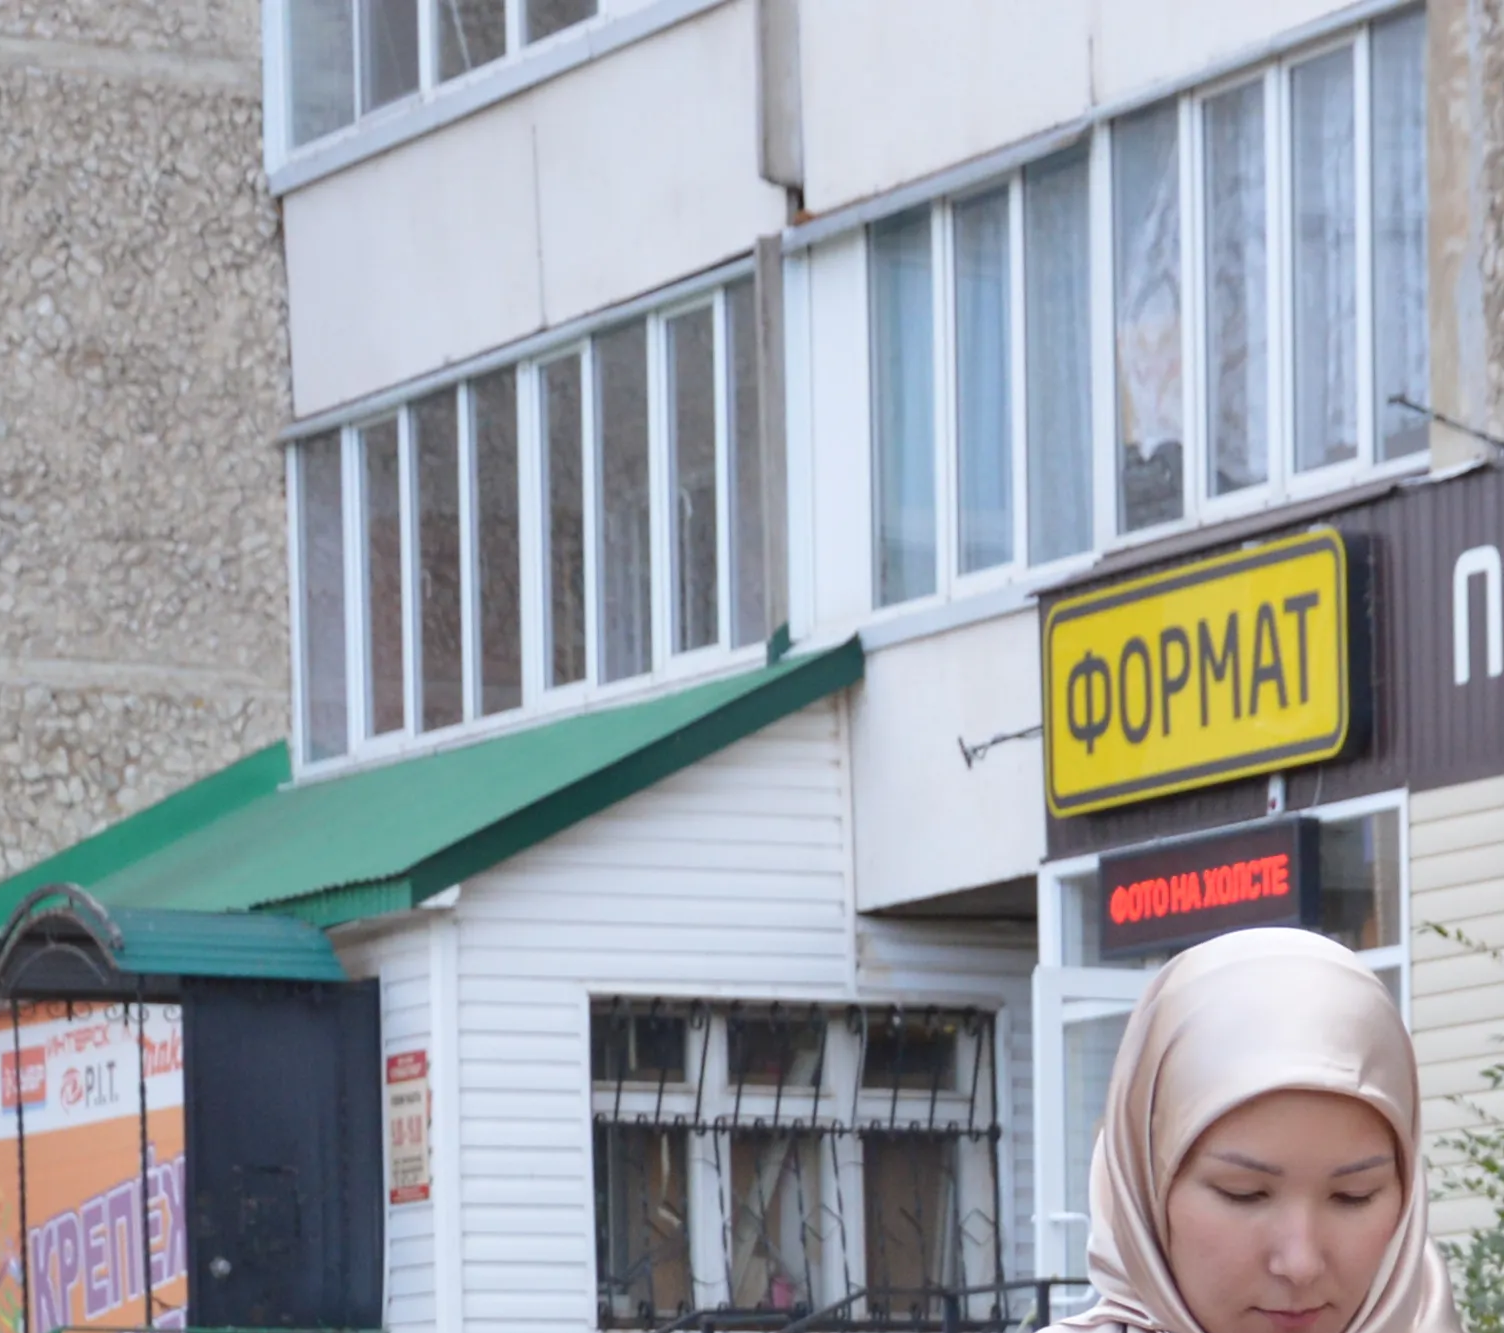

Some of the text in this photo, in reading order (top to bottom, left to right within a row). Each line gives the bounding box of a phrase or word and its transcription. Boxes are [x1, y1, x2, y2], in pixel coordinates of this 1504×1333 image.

[1066, 588, 1321, 756] ФОРМАТ
[1110, 853, 1290, 925] ФОТО НА ХОЛСТЕ
